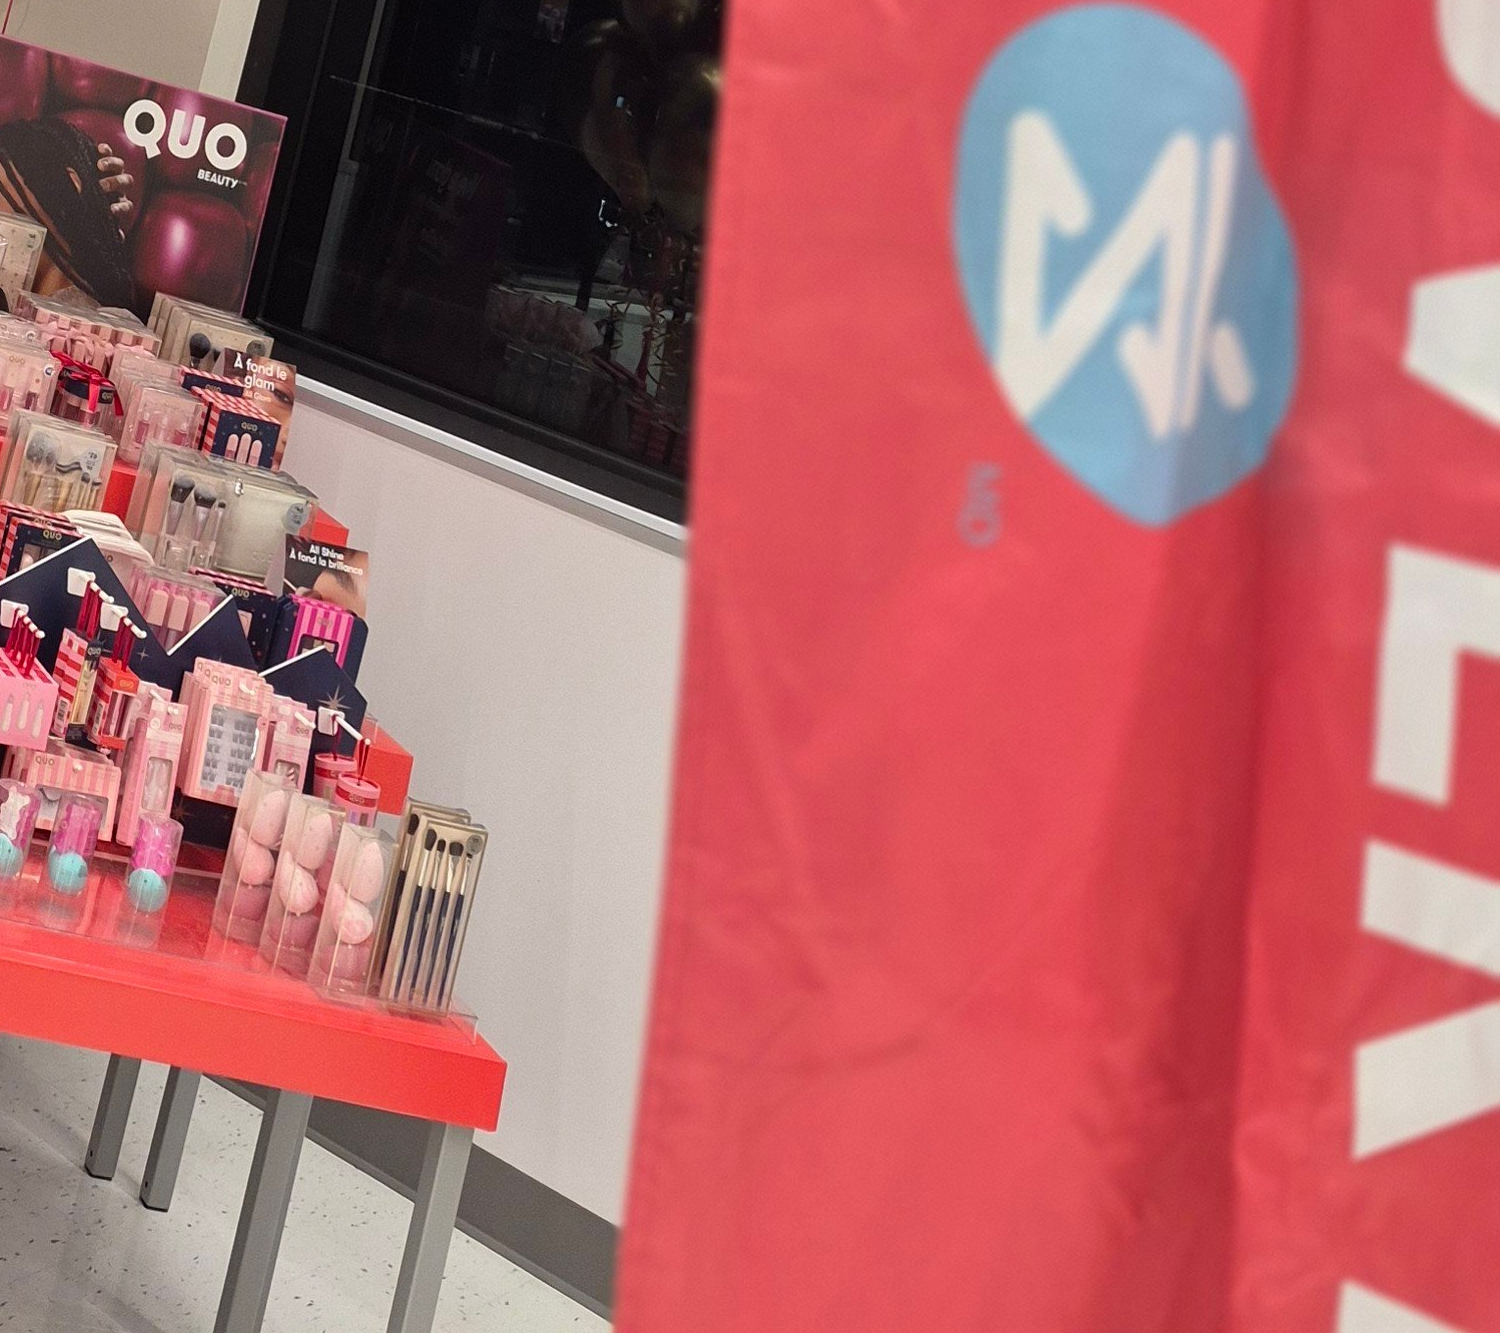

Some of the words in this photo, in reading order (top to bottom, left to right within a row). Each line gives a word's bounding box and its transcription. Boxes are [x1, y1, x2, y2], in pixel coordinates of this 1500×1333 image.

[123, 99, 247, 170] QUO
[197, 169, 239, 188] BEAUTY
[234, 353, 242, 369] À
[246, 359, 273, 376] fond
[276, 367, 287, 381] le
[244, 375, 275, 391] glam
[241, 422, 258, 431] QUO
[42, 529, 63, 541] QUO
[309, 544, 320, 556] All
[321, 546, 344, 560] Shine
[289, 548, 296, 560] À
[298, 551, 317, 565] fond
[318, 556, 327, 567] la
[328, 557, 363, 576] brillance
[232, 588, 250, 599] QUO
[211, 675, 232, 687] QUO
[35, 755, 56, 766] QUO
